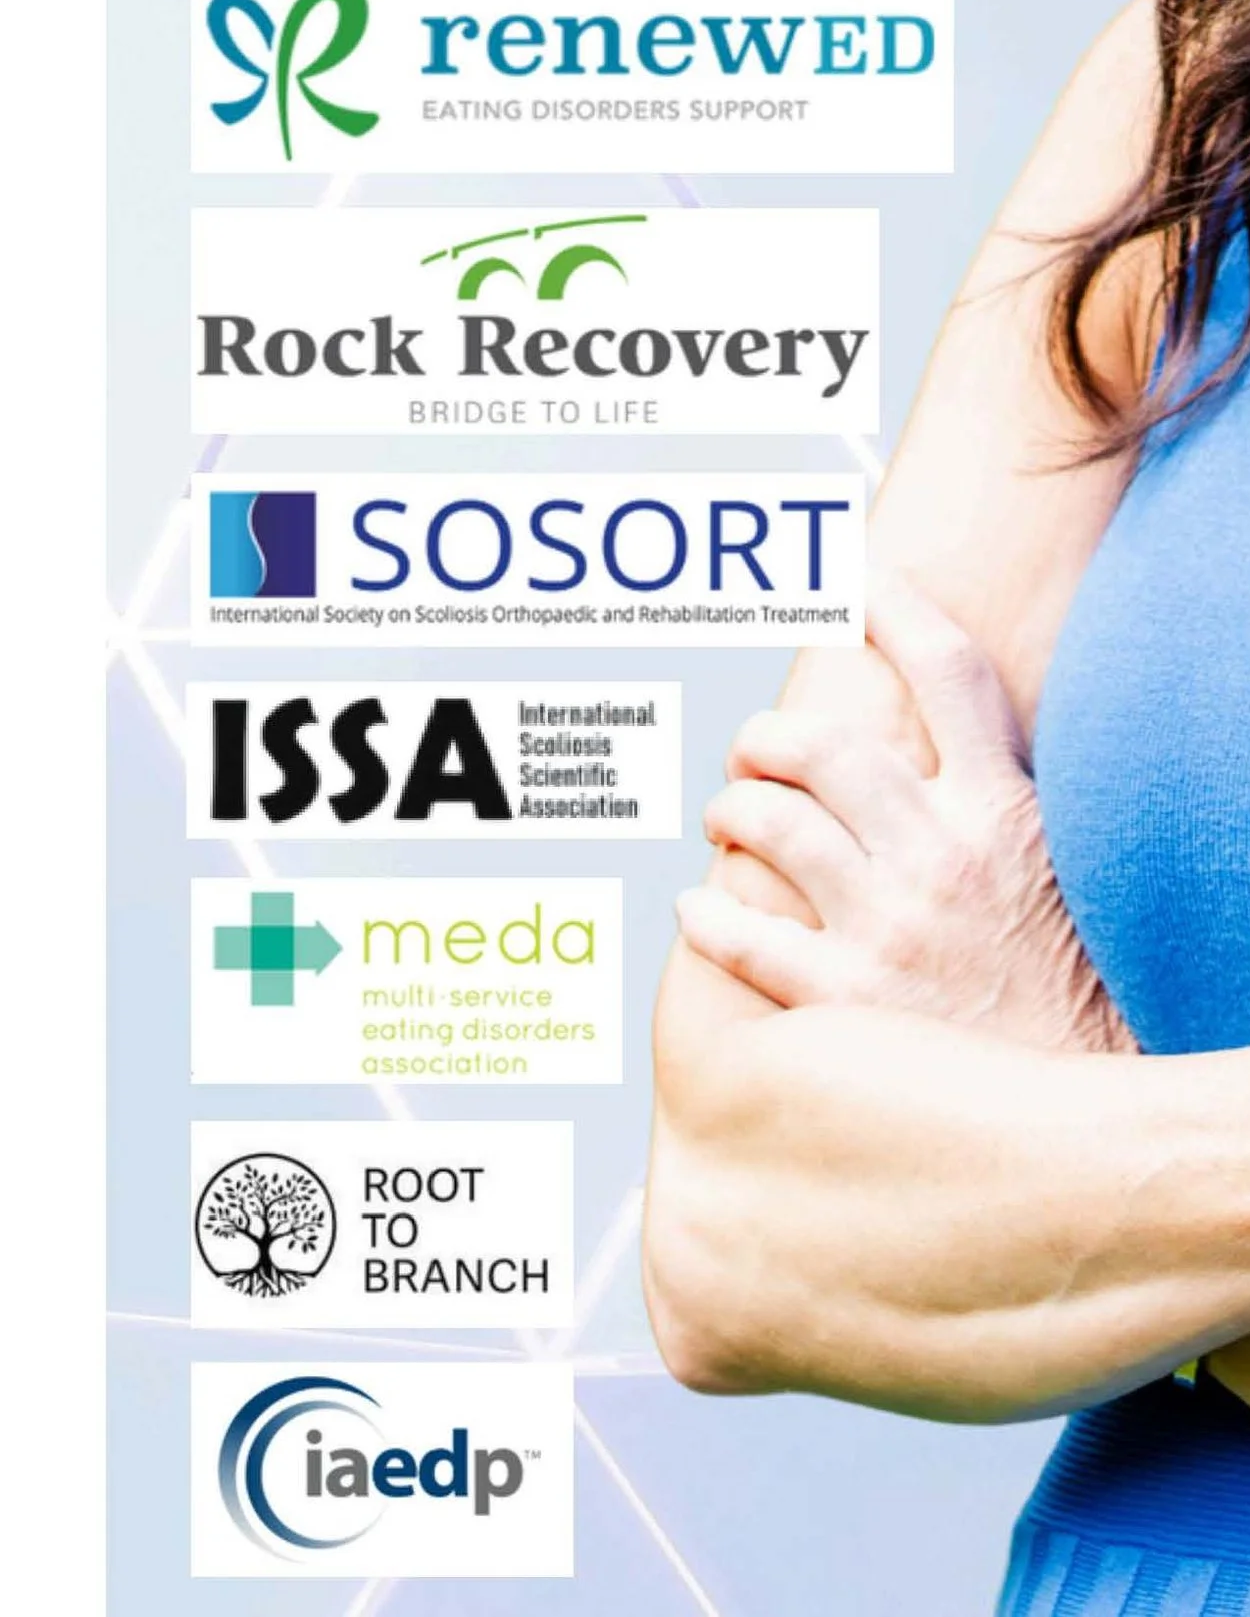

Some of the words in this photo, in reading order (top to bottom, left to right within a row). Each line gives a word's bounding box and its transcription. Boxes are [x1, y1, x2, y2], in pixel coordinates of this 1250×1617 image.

[420, 14, 935, 77] renewED
[423, 100, 521, 120] EATING
[533, 100, 679, 120] DISORDERS
[690, 100, 808, 120] SUPPORT
[197, 314, 426, 378] Rock
[458, 315, 870, 398] Recovery
[410, 401, 525, 423] BRIDGE
[541, 401, 579, 423] TO
[596, 401, 657, 423] LIFE
[350, 498, 850, 593] SOSORT
[210, 605, 319, 623] International
[323, 605, 384, 628] Society
[388, 609, 411, 623] on
[415, 605, 488, 623] Scoliosis
[492, 605, 597, 625] Orthopaedic
[602, 606, 634, 623] and
[639, 605, 755, 623] Rehabilitation
[761, 605, 849, 623] Treatment
[518, 700, 657, 726] International
[518, 732, 613, 757] Scoliosis
[210, 696, 515, 825] ISSA
[518, 762, 618, 787] Scientific
[518, 793, 640, 818] Association
[363, 902, 595, 966] meda
[362, 1018, 454, 1046] eating
[462, 1018, 595, 1041] disorders
[361, 1052, 527, 1075] association
[364, 1167, 485, 1203] ROOT
[361, 1212, 419, 1249] TO
[364, 1258, 548, 1294] BRANCH
